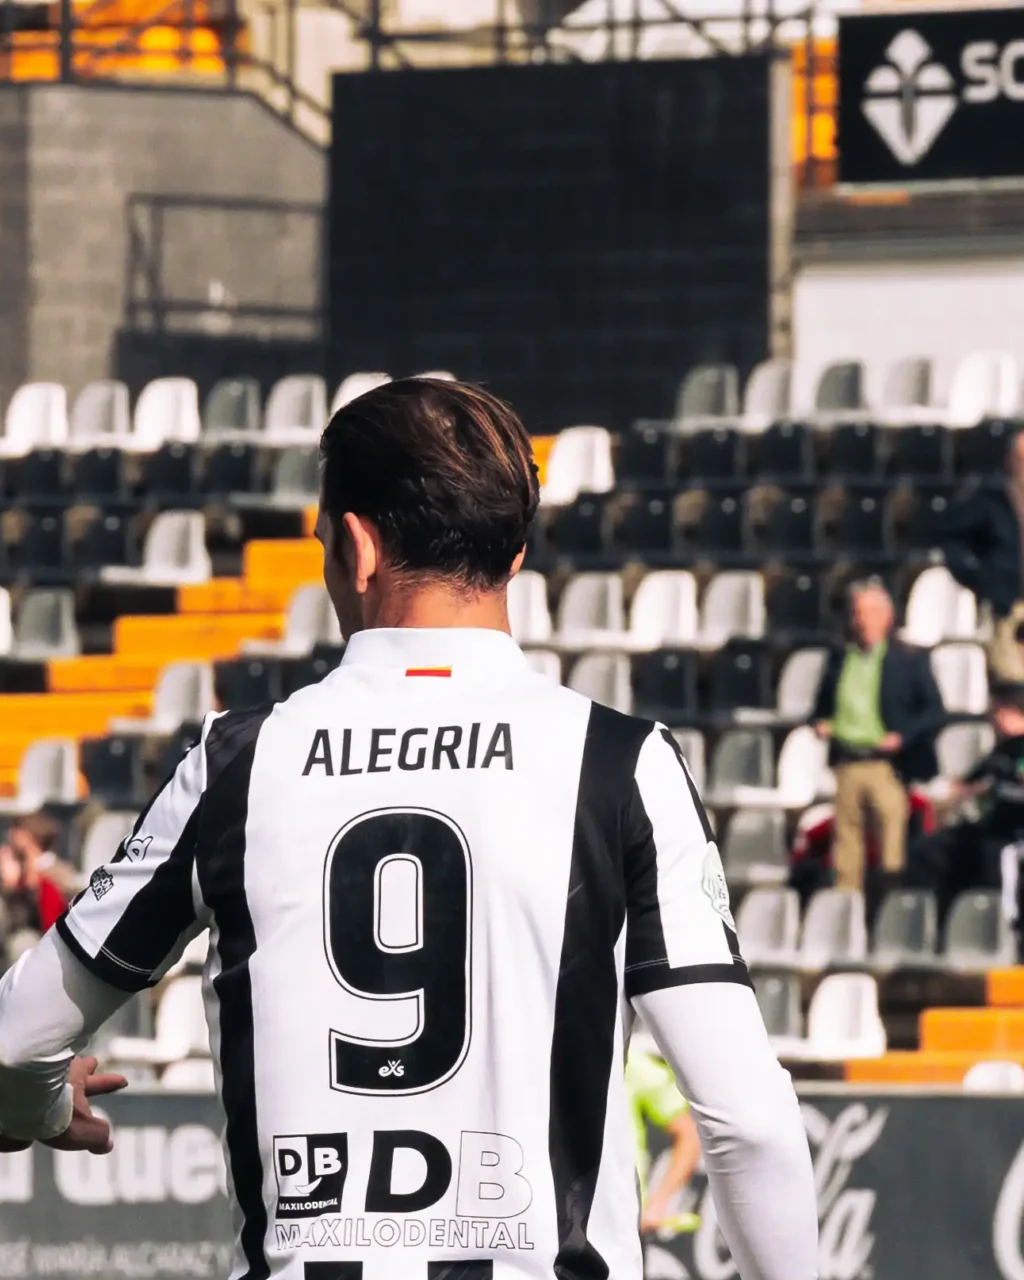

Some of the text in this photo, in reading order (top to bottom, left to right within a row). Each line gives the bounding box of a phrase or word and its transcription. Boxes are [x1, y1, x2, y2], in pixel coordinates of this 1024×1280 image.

[301, 722, 514, 777] ALEGRIA
[322, 805, 474, 1097] 9
[364, 1129, 534, 1219] DB
[274, 1217, 535, 1251] MAXILODENTAL
